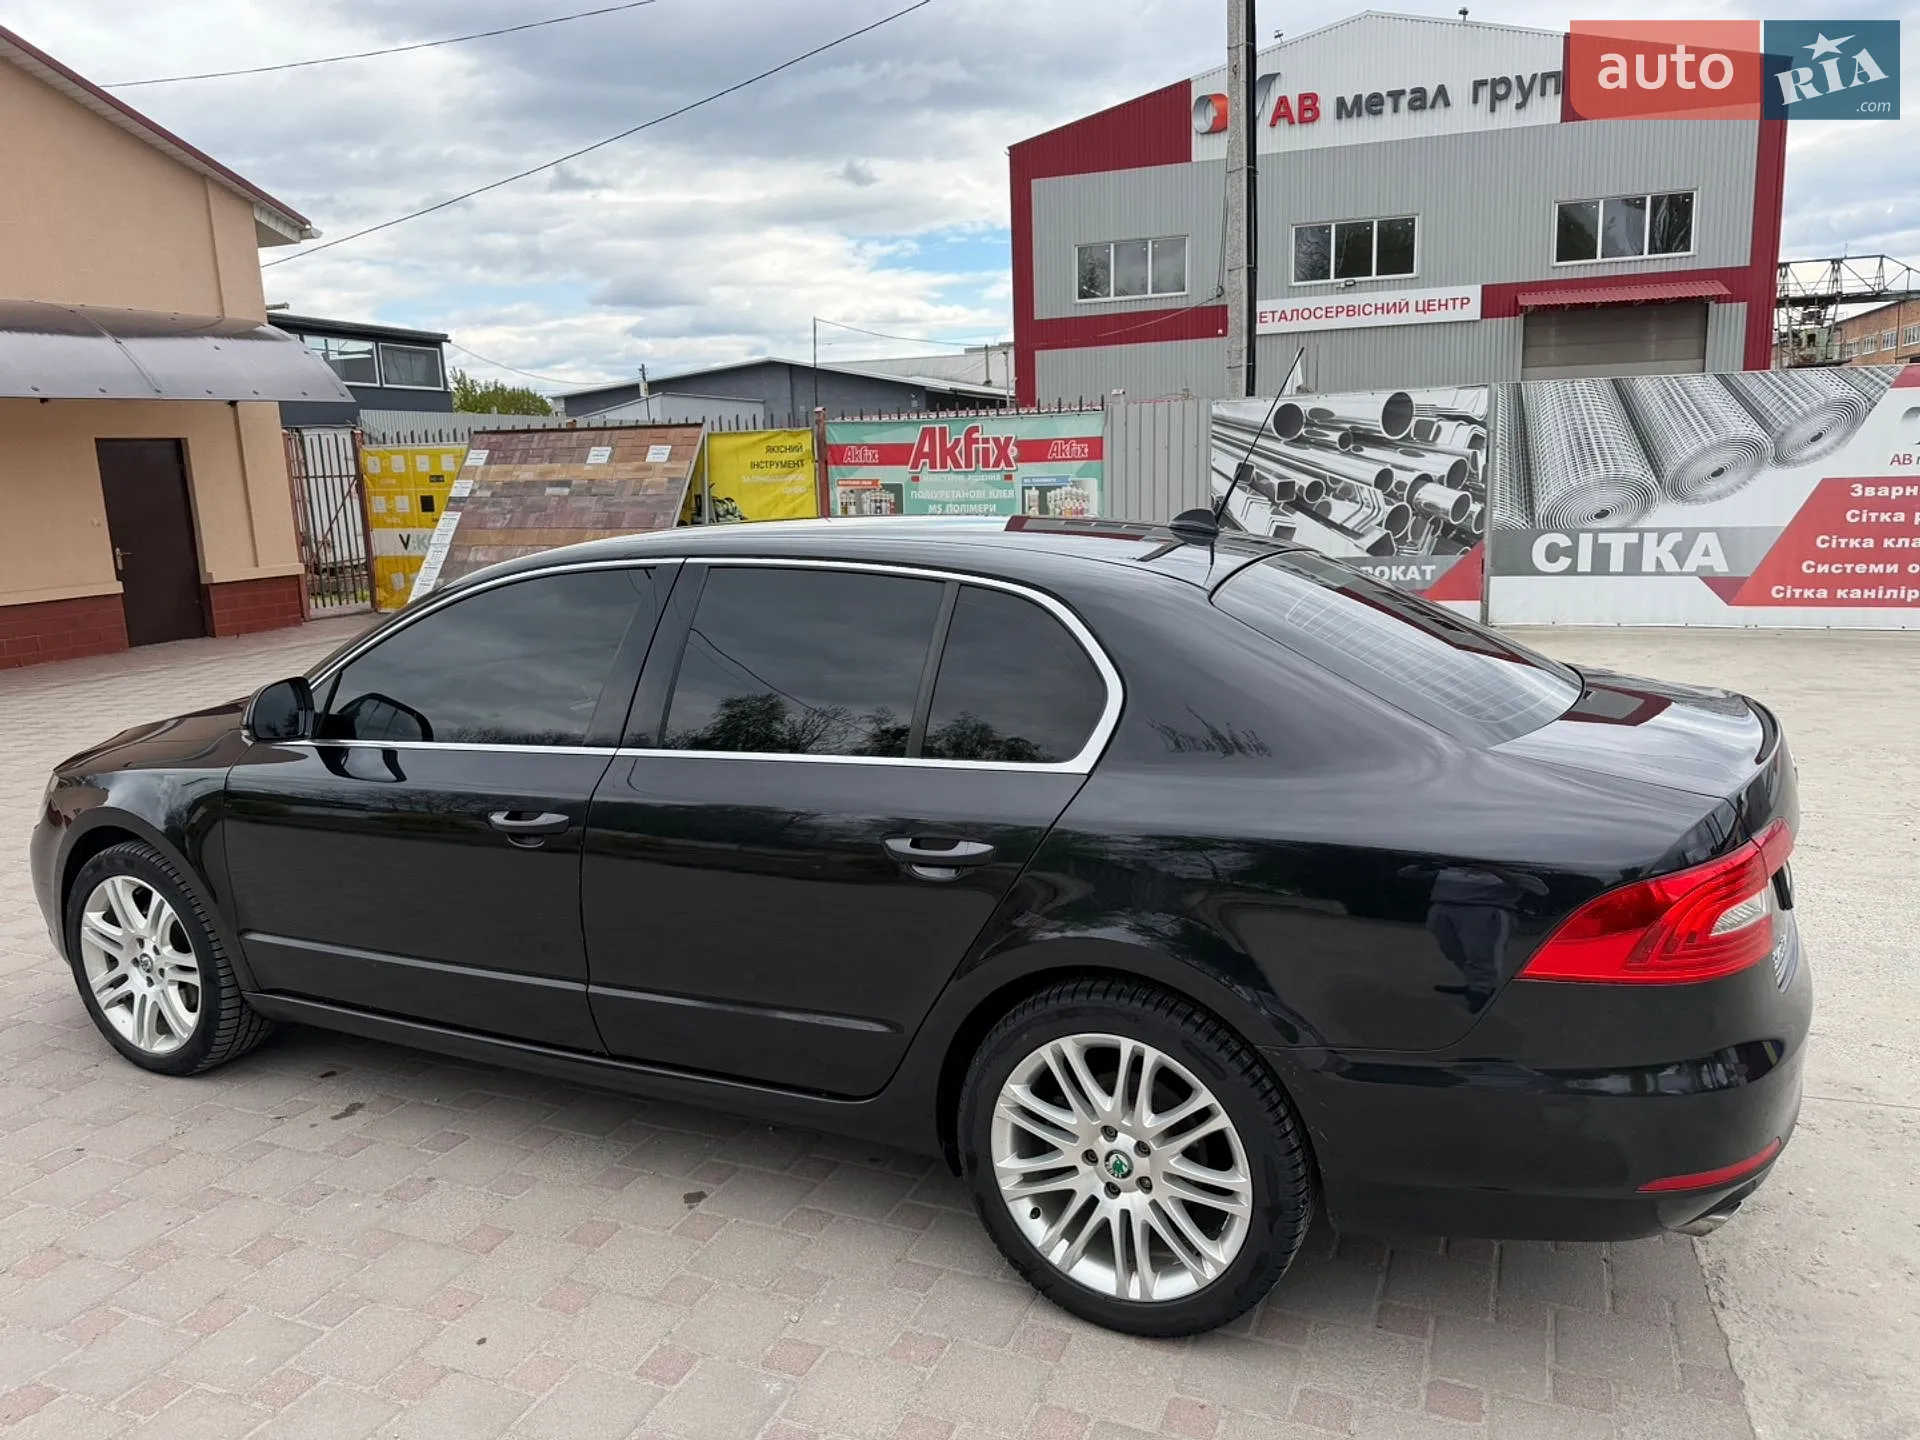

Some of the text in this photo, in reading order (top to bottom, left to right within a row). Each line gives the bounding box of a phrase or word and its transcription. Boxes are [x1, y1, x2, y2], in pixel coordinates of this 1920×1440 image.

[1269, 70, 1562, 127] АВ метал груп
[1256, 296, 1471, 324] ЕТАЛОСЕРВІСНИЙ ЦЕНТР
[765, 442, 804, 454] ЯКІСНИЙ
[843, 445, 880, 464] Akfix
[908, 424, 1018, 472] Akfix
[1048, 440, 1089, 460] Akfix
[750, 459, 805, 470] ІНСТРУМЕНТ
[1889, 453, 1913, 466] АВ
[1849, 483, 1919, 500] Зварн
[946, 503, 997, 514] ПОЛІМЕРИ
[1845, 509, 1905, 523] Сітка
[1815, 535, 1875, 548] Сітка
[1531, 532, 1730, 574] СІТКА
[1801, 560, 1899, 574] Системи
[1771, 585, 1920, 603] Сітка канілір
